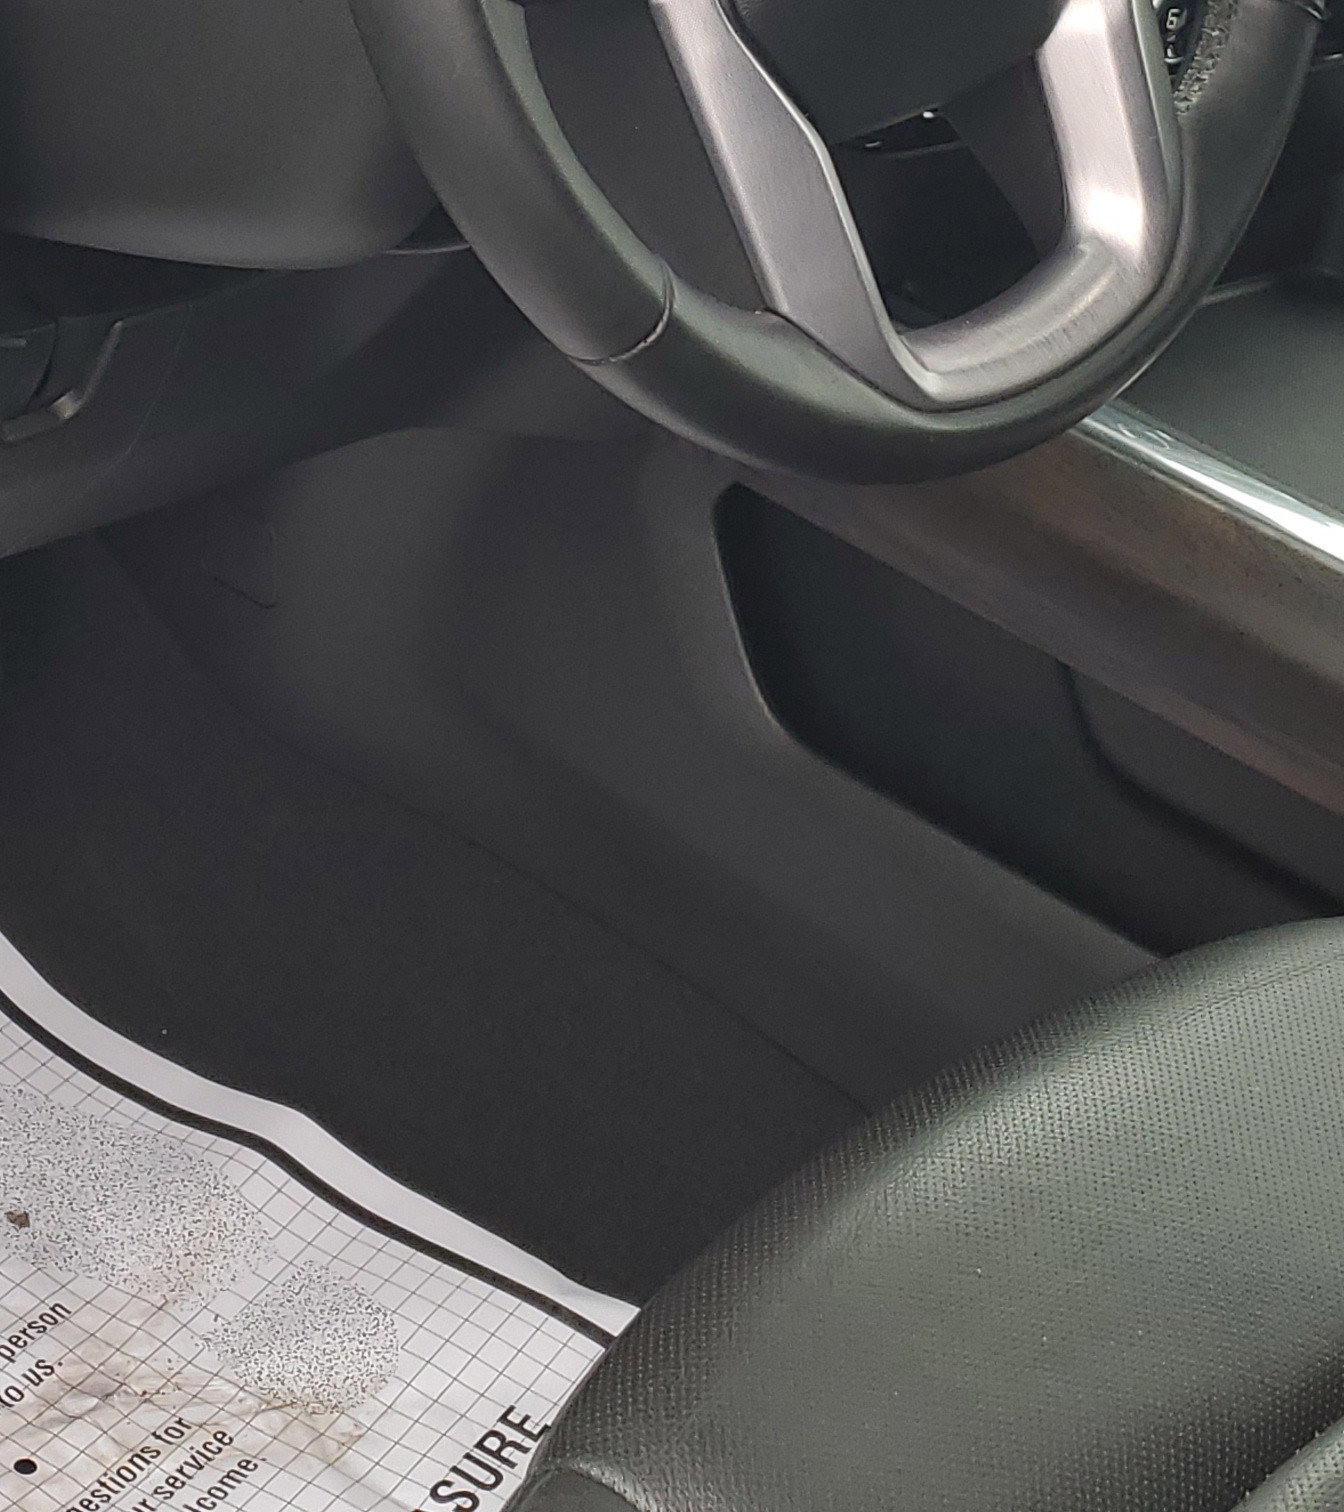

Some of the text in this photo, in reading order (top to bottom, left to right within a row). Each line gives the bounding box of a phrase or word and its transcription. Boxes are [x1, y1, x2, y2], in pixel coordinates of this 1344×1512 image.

[21, 1357, 65, 1387] us.
[151, 1415, 193, 1446] for
[153, 1428, 235, 1501] service
